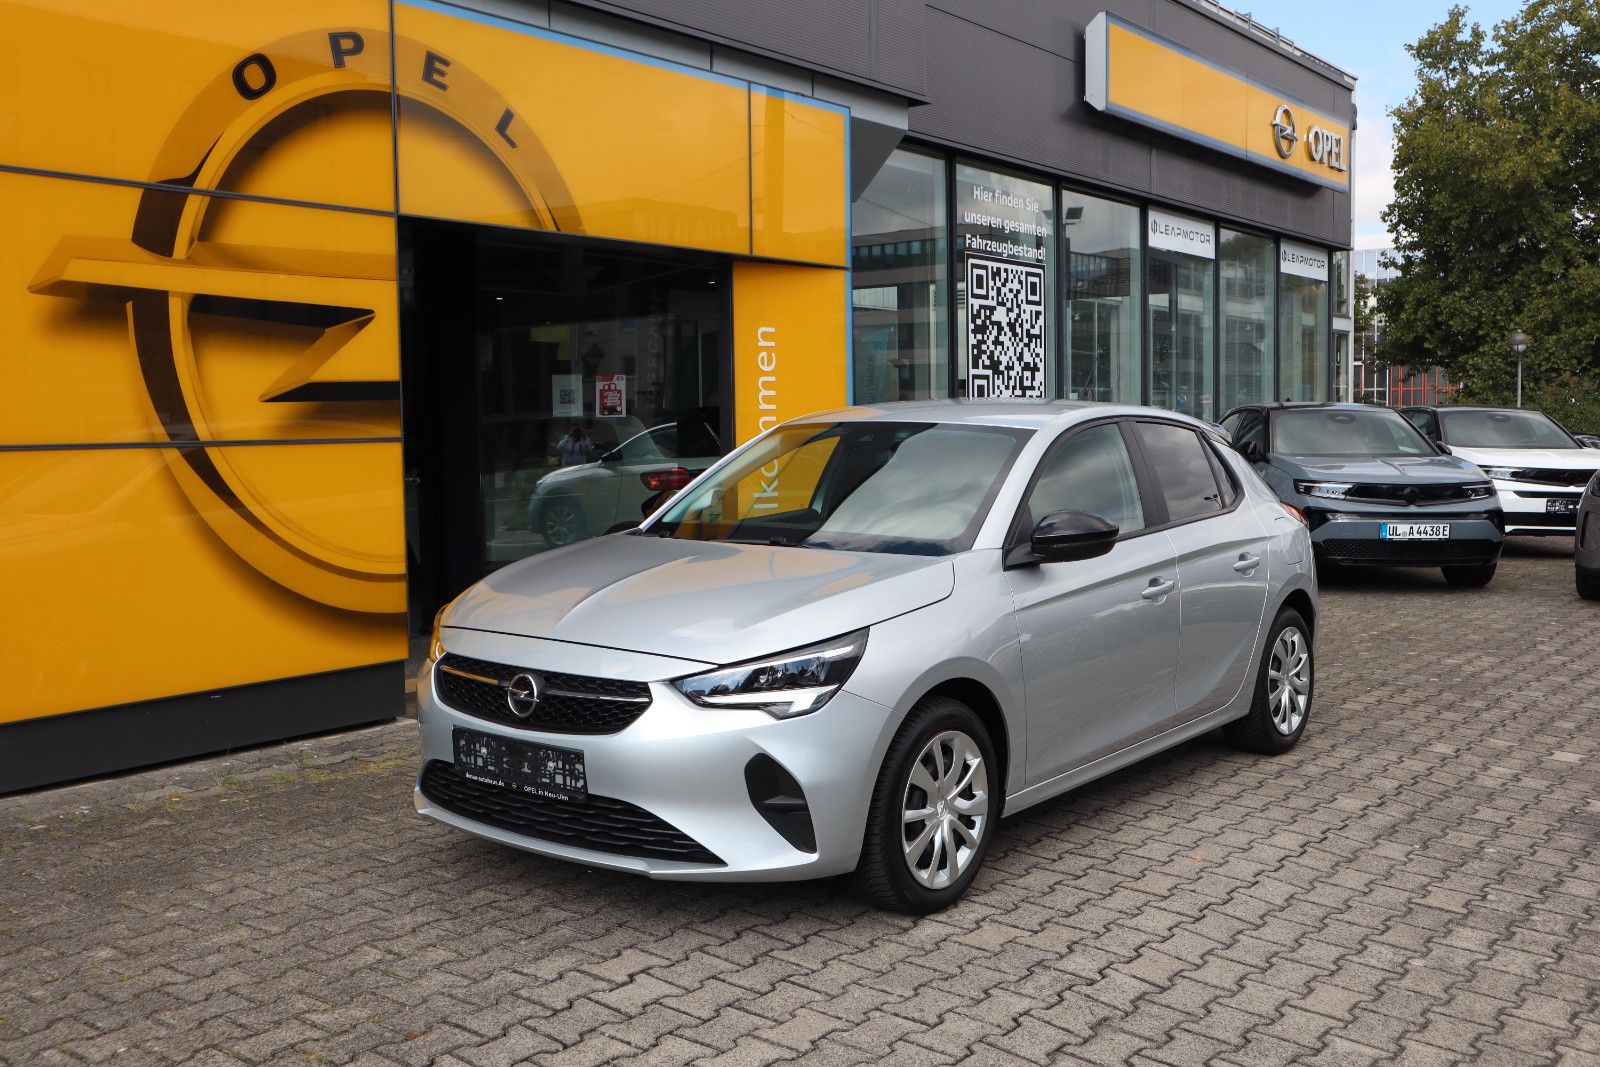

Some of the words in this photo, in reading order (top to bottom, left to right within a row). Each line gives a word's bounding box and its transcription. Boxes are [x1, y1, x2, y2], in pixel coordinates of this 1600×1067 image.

[232, 31, 518, 150] OPEL
[1308, 124, 1346, 172] OPEL
[973, 185, 993, 202] Hier
[995, 189, 1024, 210] finden
[1026, 198, 1039, 213] Sie
[965, 211, 1002, 229] unseren
[1004, 219, 1047, 238] gesamten
[1158, 223, 1211, 245] LEAPMOTOR
[966, 233, 1046, 261] Fahrzeugbestand!
[1287, 251, 1326, 269] LEAPMOTOR
[1388, 525, 1401, 536] UL
[1408, 525, 1414, 536] A
[523, 785, 537, 795] OPEL
[538, 788, 544, 796] in
[544, 790, 569, 801] Neu-Ulm
